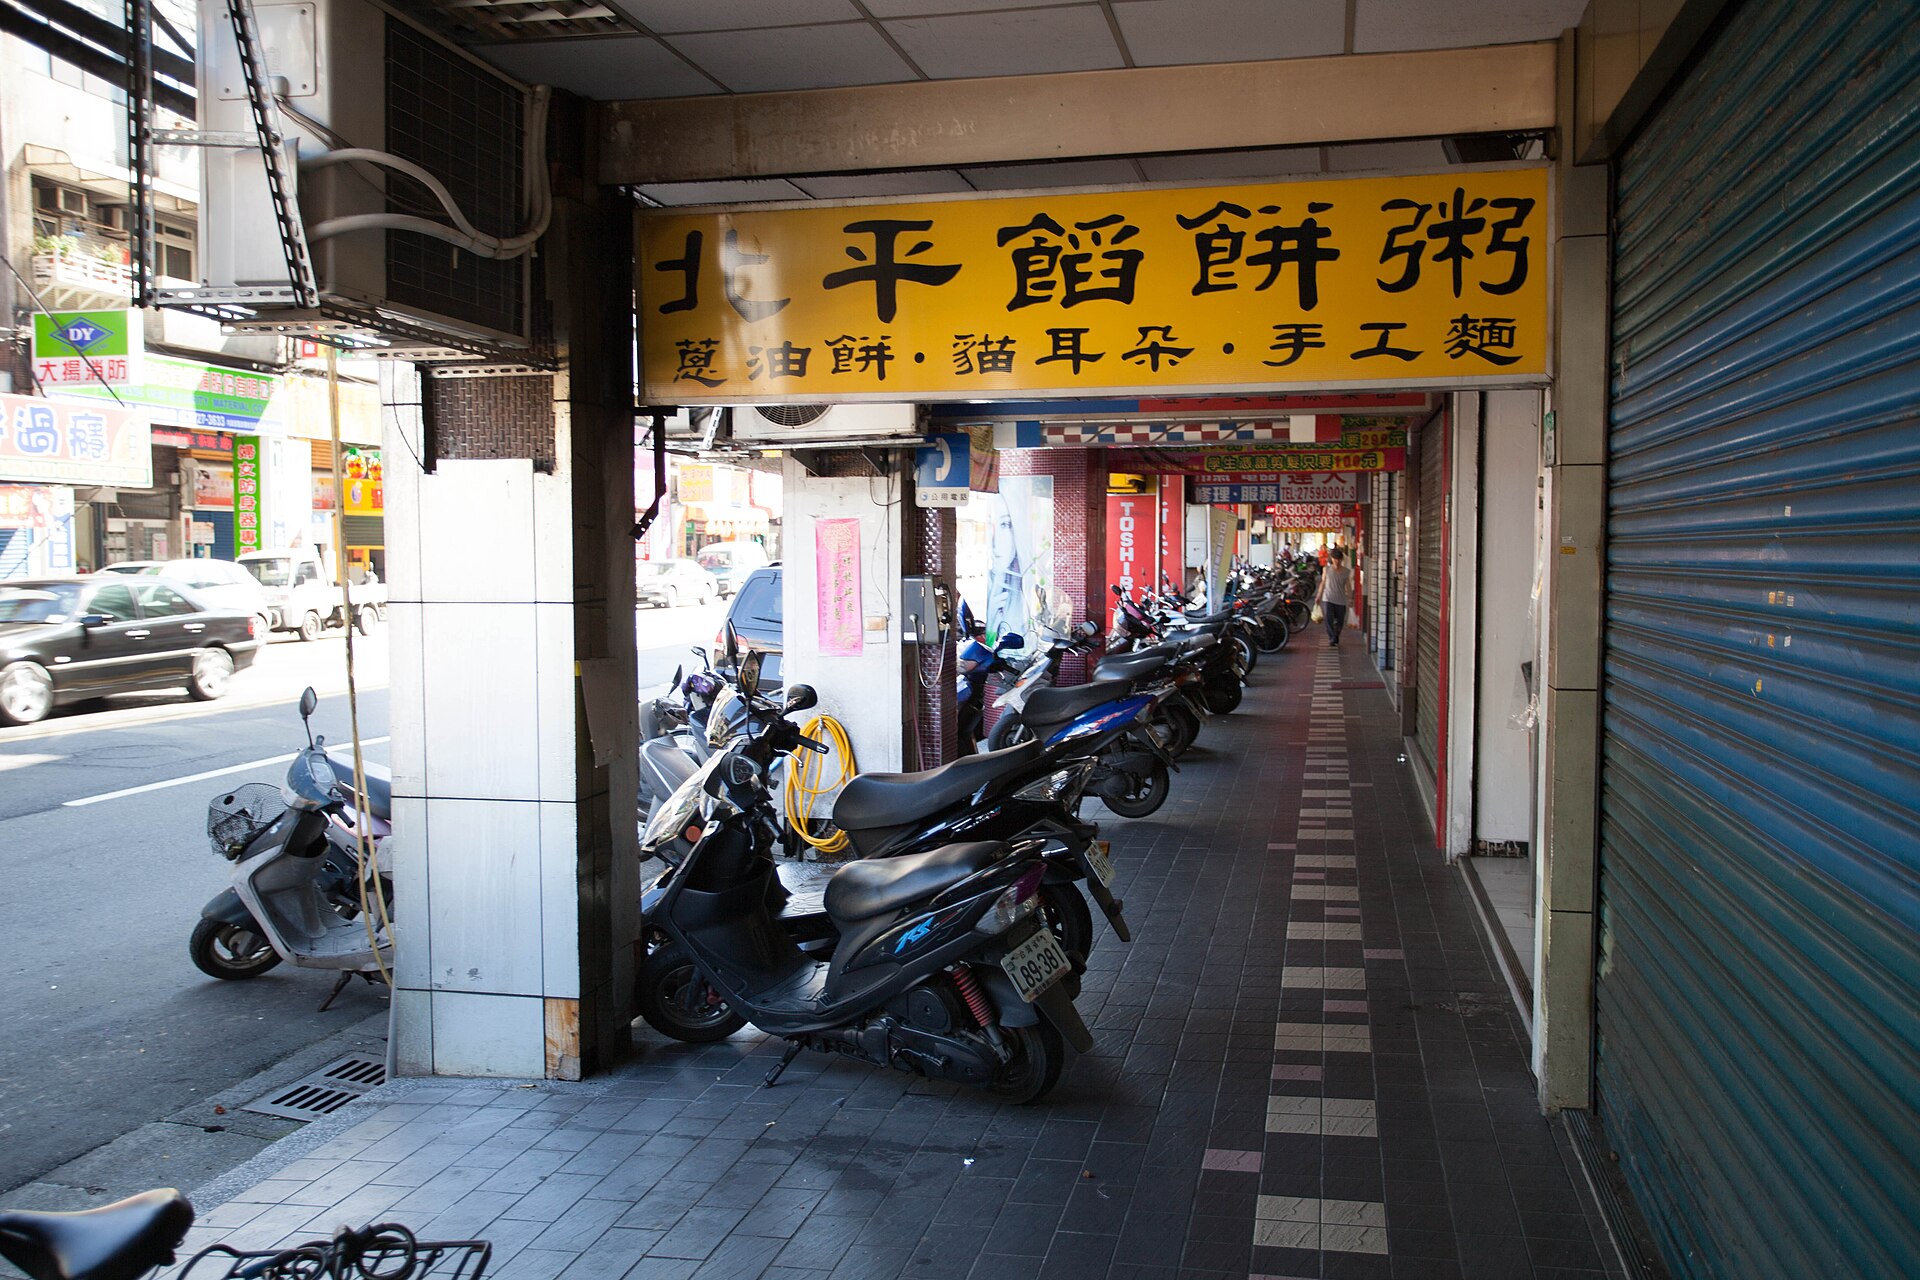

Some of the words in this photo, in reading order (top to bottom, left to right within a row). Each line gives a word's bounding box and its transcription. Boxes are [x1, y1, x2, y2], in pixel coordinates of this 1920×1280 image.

[655, 187, 1535, 323] 北平餡餅粥
[68, 328, 95, 341] DY
[0, 404, 107, 459] 過癮
